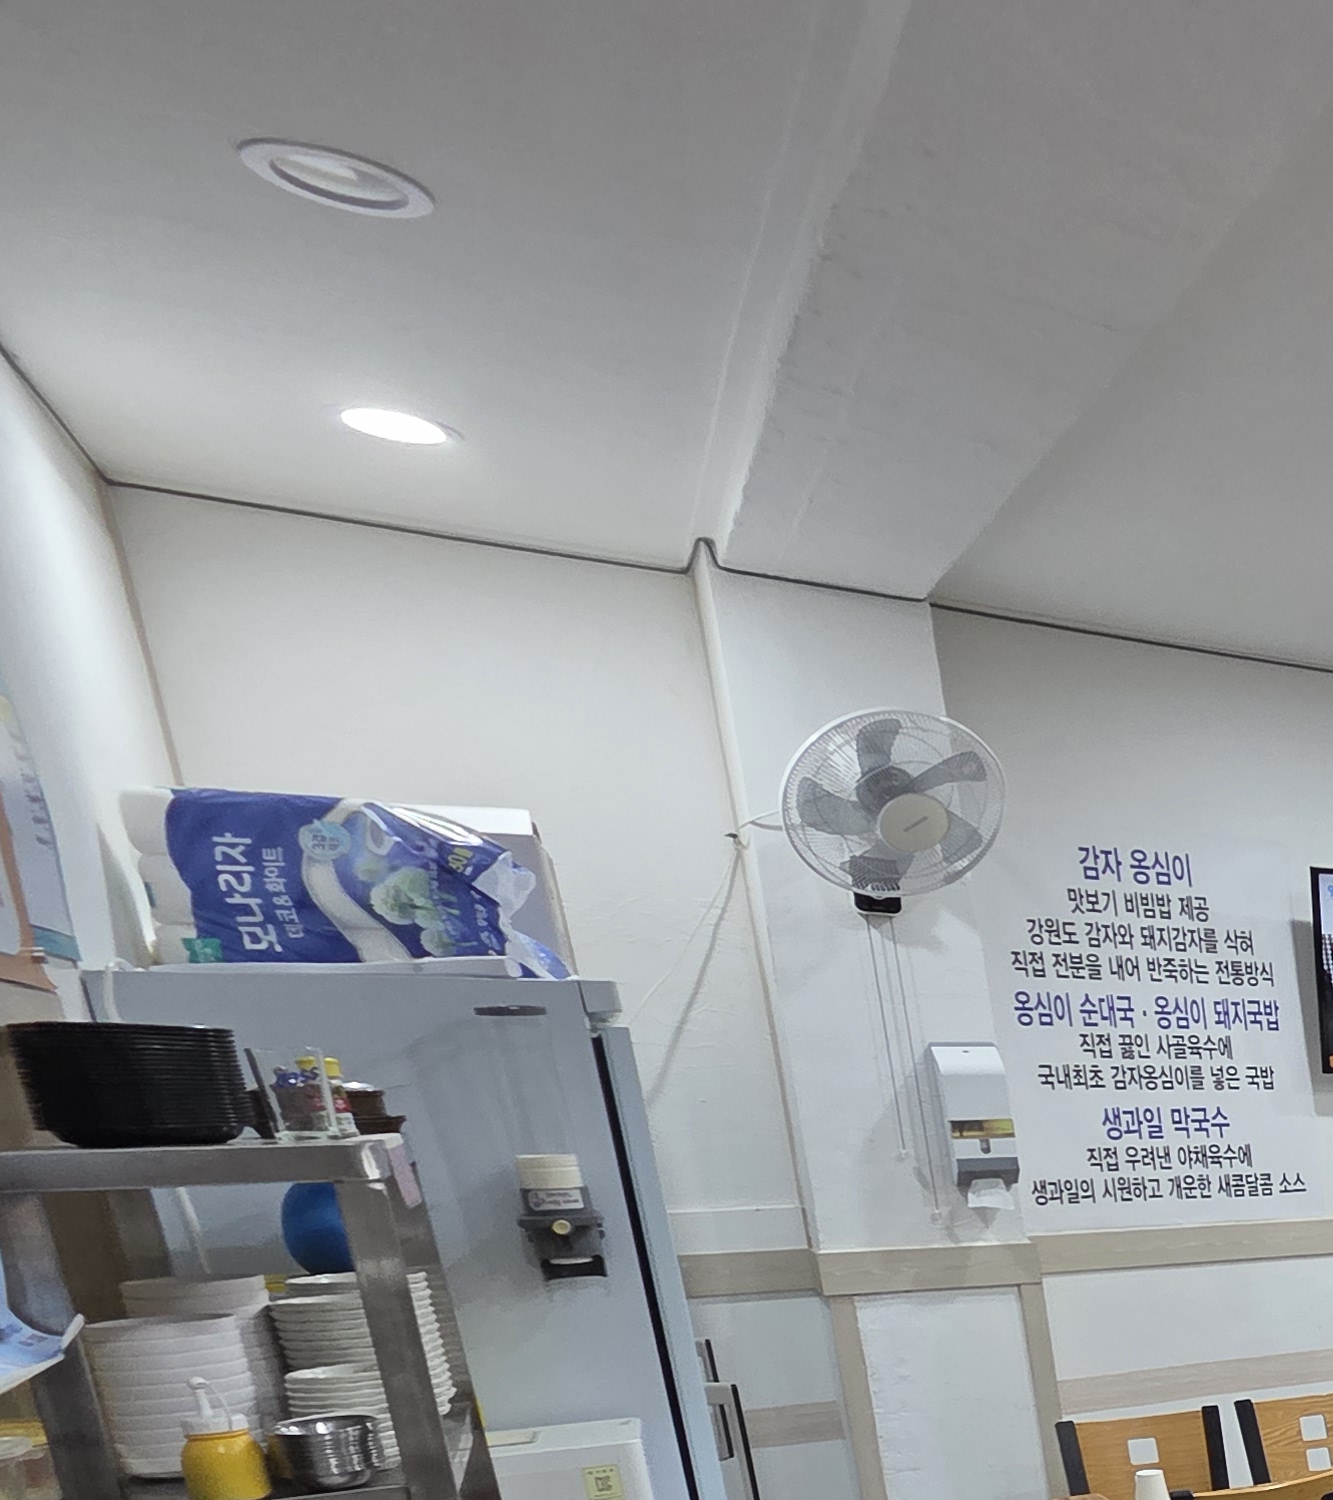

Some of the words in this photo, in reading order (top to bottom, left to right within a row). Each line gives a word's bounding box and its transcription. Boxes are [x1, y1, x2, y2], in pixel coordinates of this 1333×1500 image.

[1078, 846, 1122, 882] 감자
[1130, 850, 1192, 887] 옹심이
[212, 832, 282, 953] 모나리자
[1068, 888, 1118, 916] 맛보기
[1124, 892, 1171, 918] 비빔밥
[1179, 896, 1209, 922] 제공
[1027, 918, 1079, 946] 강원도
[1085, 922, 1134, 949] 감자와
[1140, 926, 1218, 953] 돼지감자를
[1011, 951, 1045, 978] 직접
[1052, 952, 1102, 980] 전분을
[1109, 957, 1141, 982] 내어
[1146, 958, 1209, 984] 반죽하는
[1215, 960, 1274, 987] 전통방식
[1014, 991, 1072, 1027] 옹심이
[1079, 993, 1135, 1028] 순대국
[1154, 996, 1207, 1030] 옹심이
[1214, 999, 1279, 1031] 돼지국밥
[1079, 1033, 1113, 1058] 직접
[1118, 1034, 1150, 1060] 끓인
[1157, 1035, 1232, 1060] 사골육수에
[1038, 1064, 1106, 1090] 국내최초
[1111, 1065, 1205, 1090] 감자옹심이를
[1210, 1066, 1239, 1091] 넣은
[1245, 1066, 1274, 1090] 국밥
[1102, 1107, 1163, 1140] 생과일
[1171, 1107, 1230, 1139] 막국수
[1087, 1148, 1119, 1171] 직접
[1125, 1145, 1171, 1170] 우려낸
[1178, 1144, 1253, 1168] 야채육수에
[1031, 1179, 1096, 1206] 생과일의
[1102, 1177, 1163, 1202] 시원하고
[1168, 1175, 1212, 1199] 개운한
[1218, 1174, 1273, 1197] 새콤달콤
[1279, 1173, 1307, 1194] 소스
